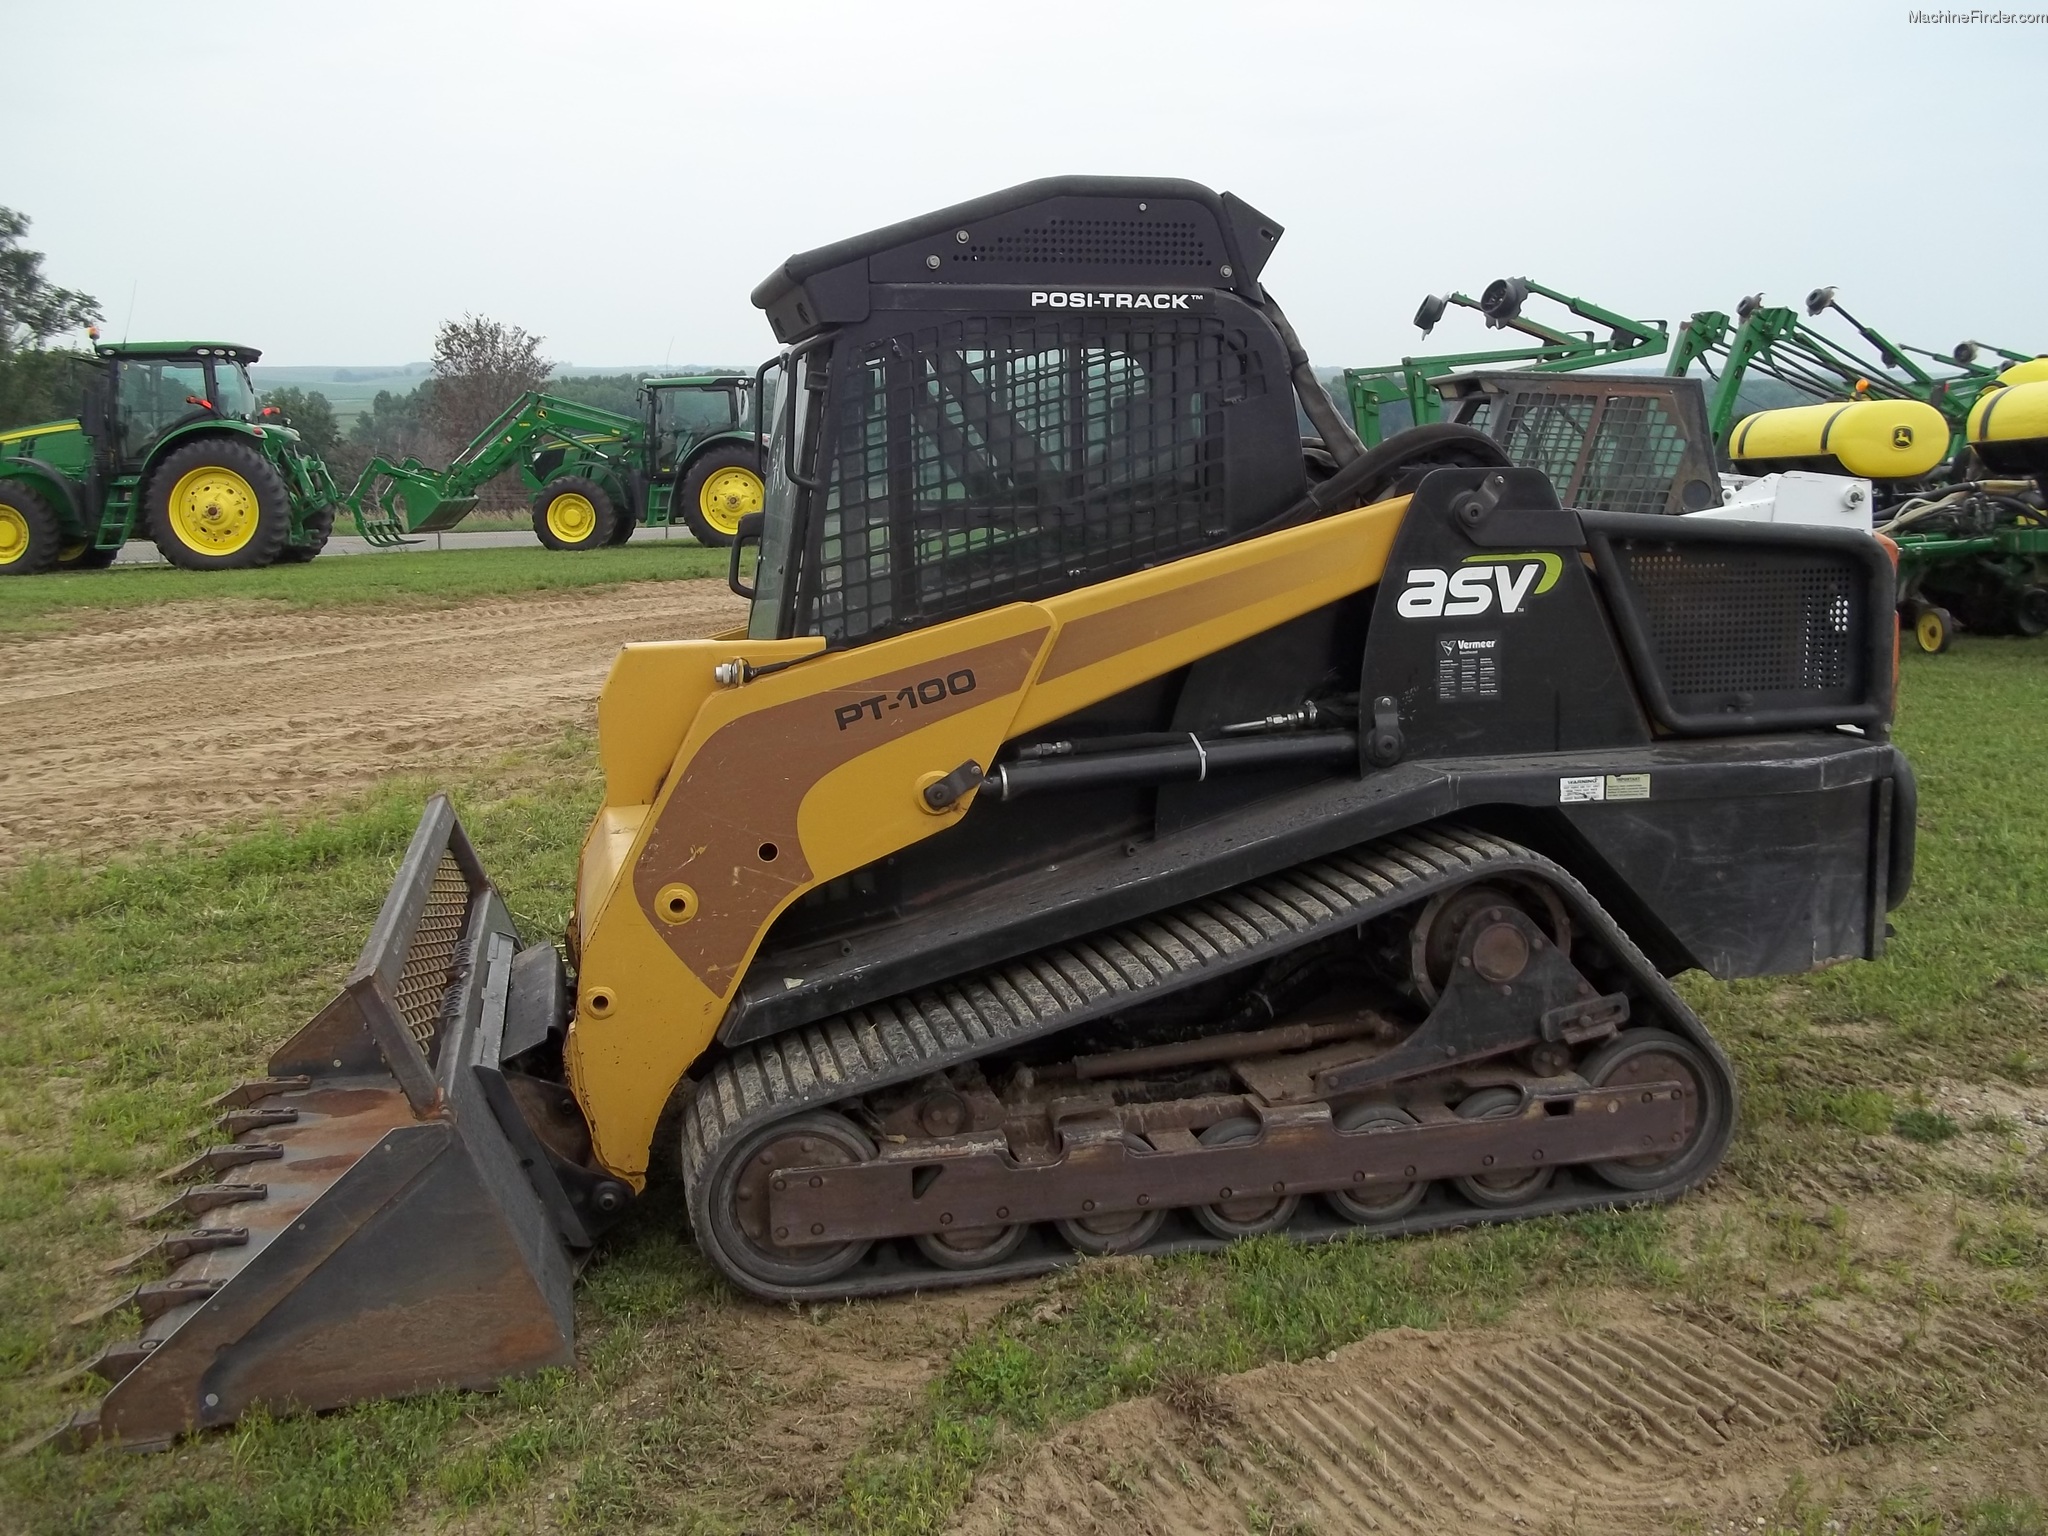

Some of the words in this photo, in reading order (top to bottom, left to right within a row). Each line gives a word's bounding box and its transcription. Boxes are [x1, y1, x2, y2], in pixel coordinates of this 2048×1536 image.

[1031, 292, 1190, 309] POSI-TRACK
[1457, 640, 1496, 650] Vermeer
[834, 668, 977, 732] PT-100
